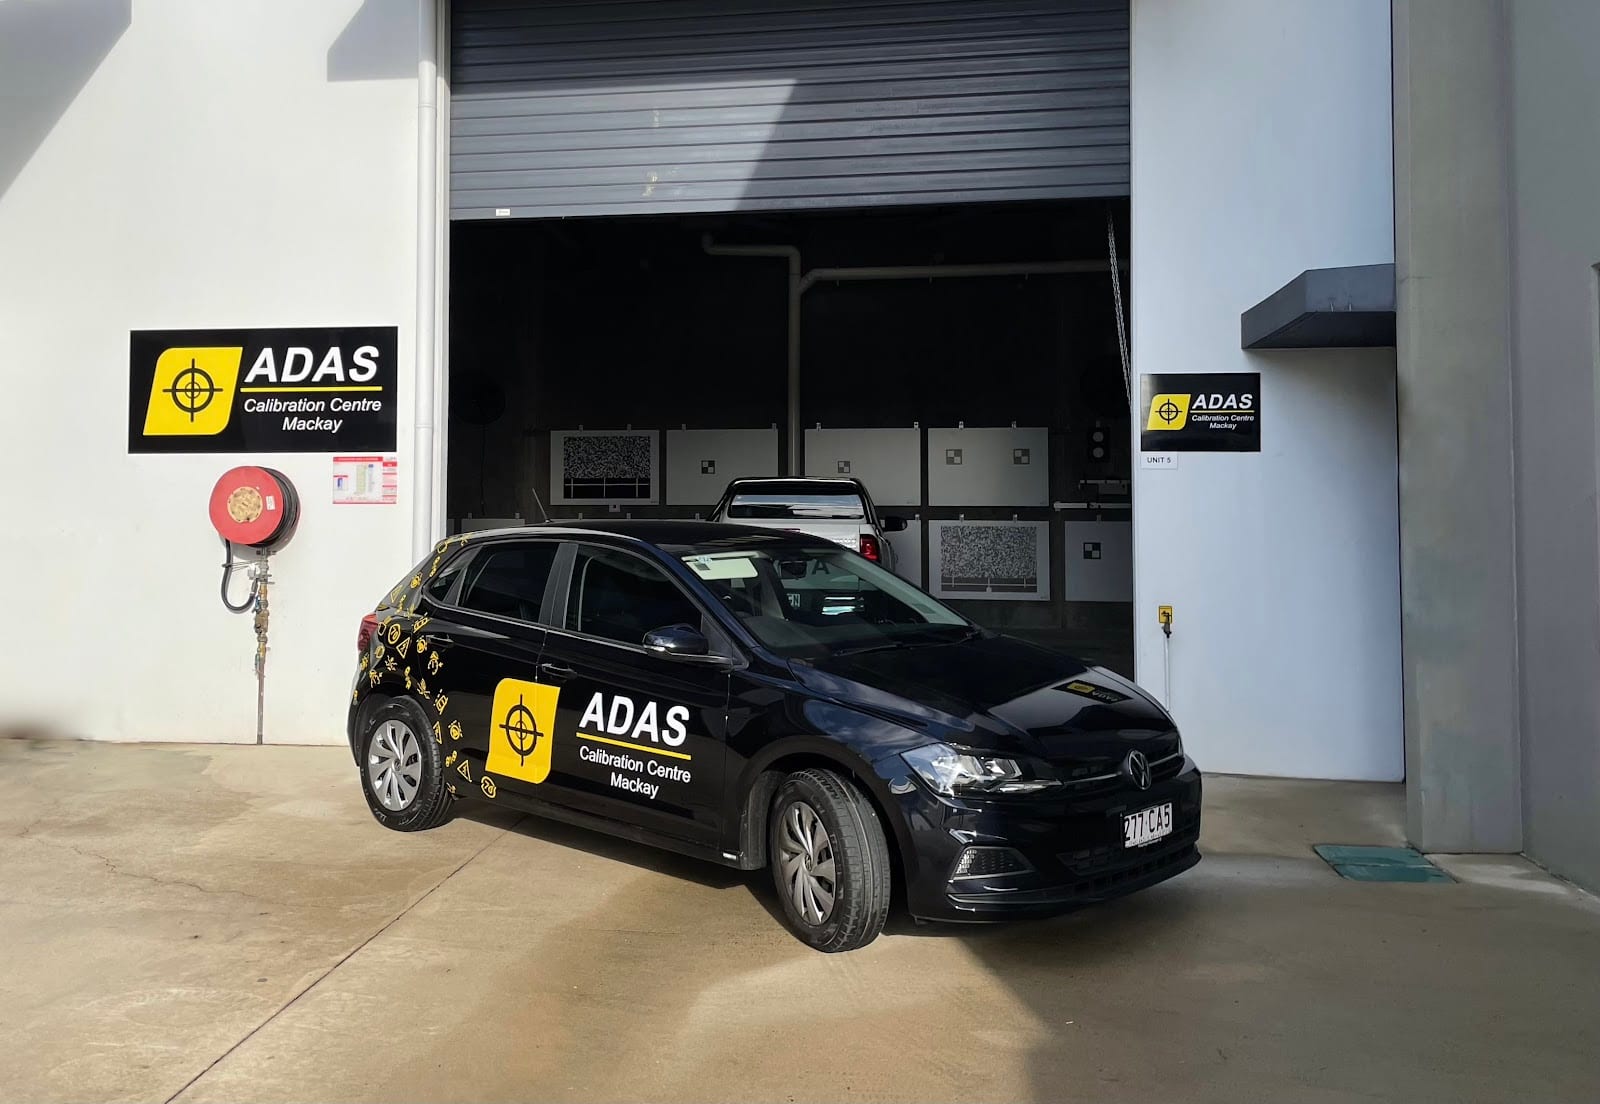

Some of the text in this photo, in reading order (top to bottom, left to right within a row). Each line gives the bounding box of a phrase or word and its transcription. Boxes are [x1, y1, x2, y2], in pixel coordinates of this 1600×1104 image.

[243, 345, 380, 383] ADAS
[243, 397, 382, 413] Calibration Centre
[1191, 393, 1253, 410] ADAS
[282, 416, 343, 434] Mackay
[1191, 414, 1255, 422] Calibration Centre
[1209, 422, 1237, 431] Mackay
[579, 691, 690, 747] ADAS
[579, 745, 692, 784] Calibration Centre
[610, 771, 660, 800] Mackay
